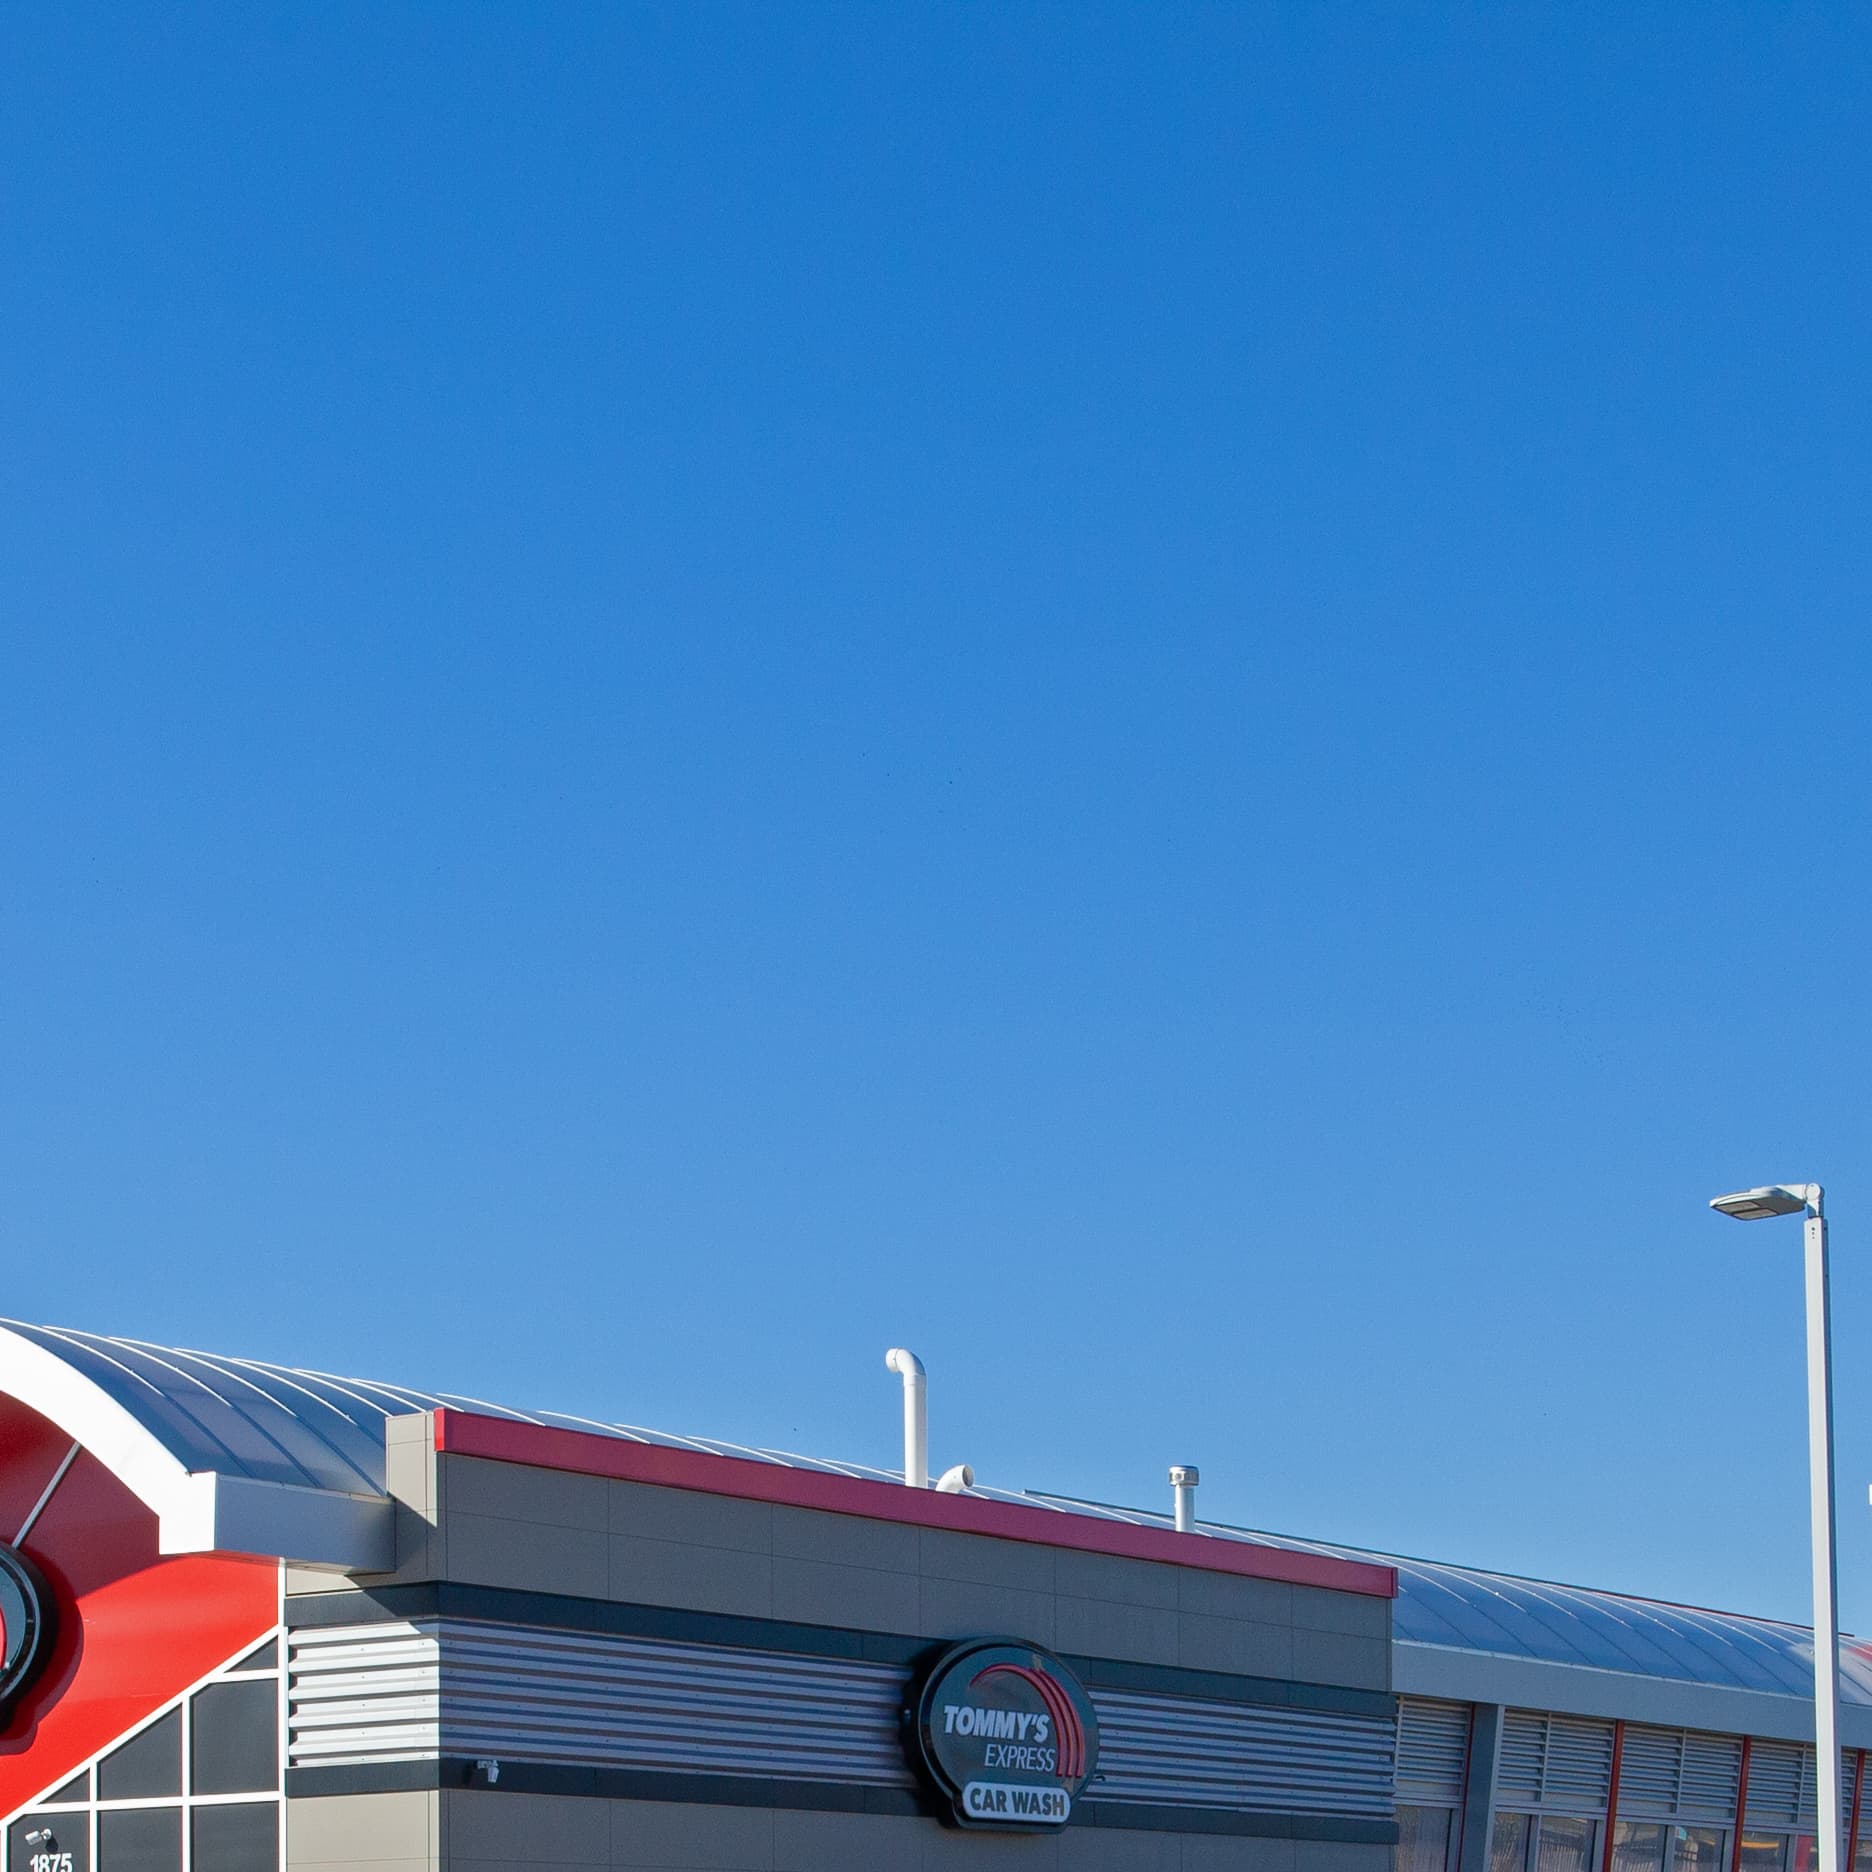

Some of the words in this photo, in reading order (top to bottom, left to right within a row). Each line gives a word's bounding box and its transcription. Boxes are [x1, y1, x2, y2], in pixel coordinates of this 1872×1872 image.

[943, 1705, 1050, 1743] TOMMY'S
[984, 1743, 1056, 1772] EXPRESS
[969, 1788, 1008, 1813] CAR
[1012, 1791, 1065, 1816] WASH
